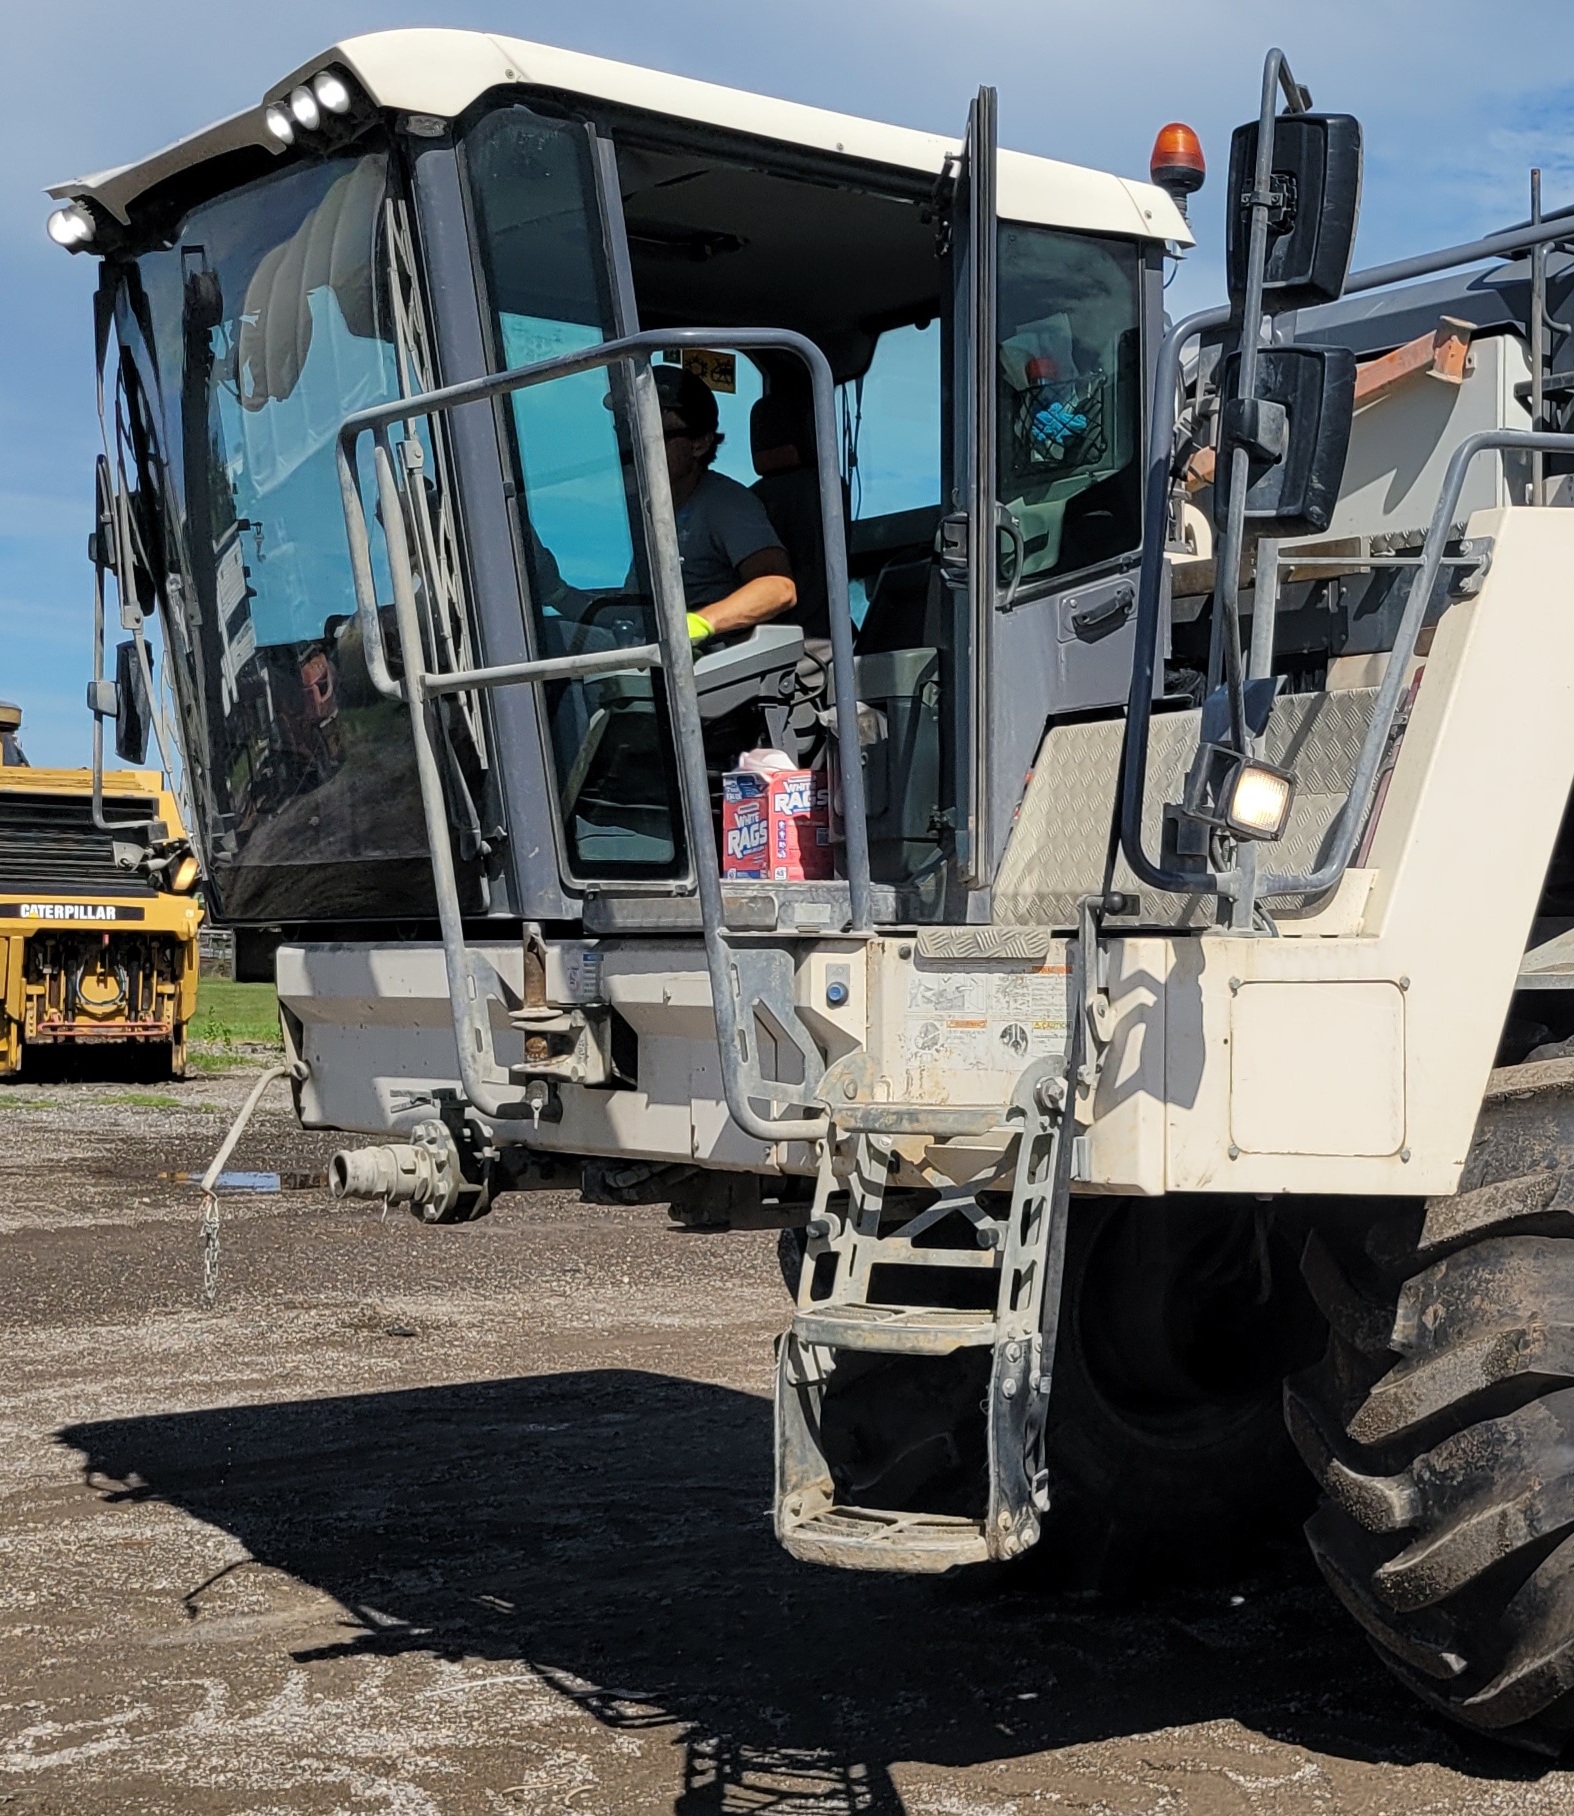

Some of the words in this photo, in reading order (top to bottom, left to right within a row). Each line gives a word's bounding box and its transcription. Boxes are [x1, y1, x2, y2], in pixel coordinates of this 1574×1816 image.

[774, 790, 828, 816] RAGS
[734, 812, 760, 828] WHITE
[728, 820, 768, 859] RAGS
[20, 903, 116, 920] CATERPILLAR
